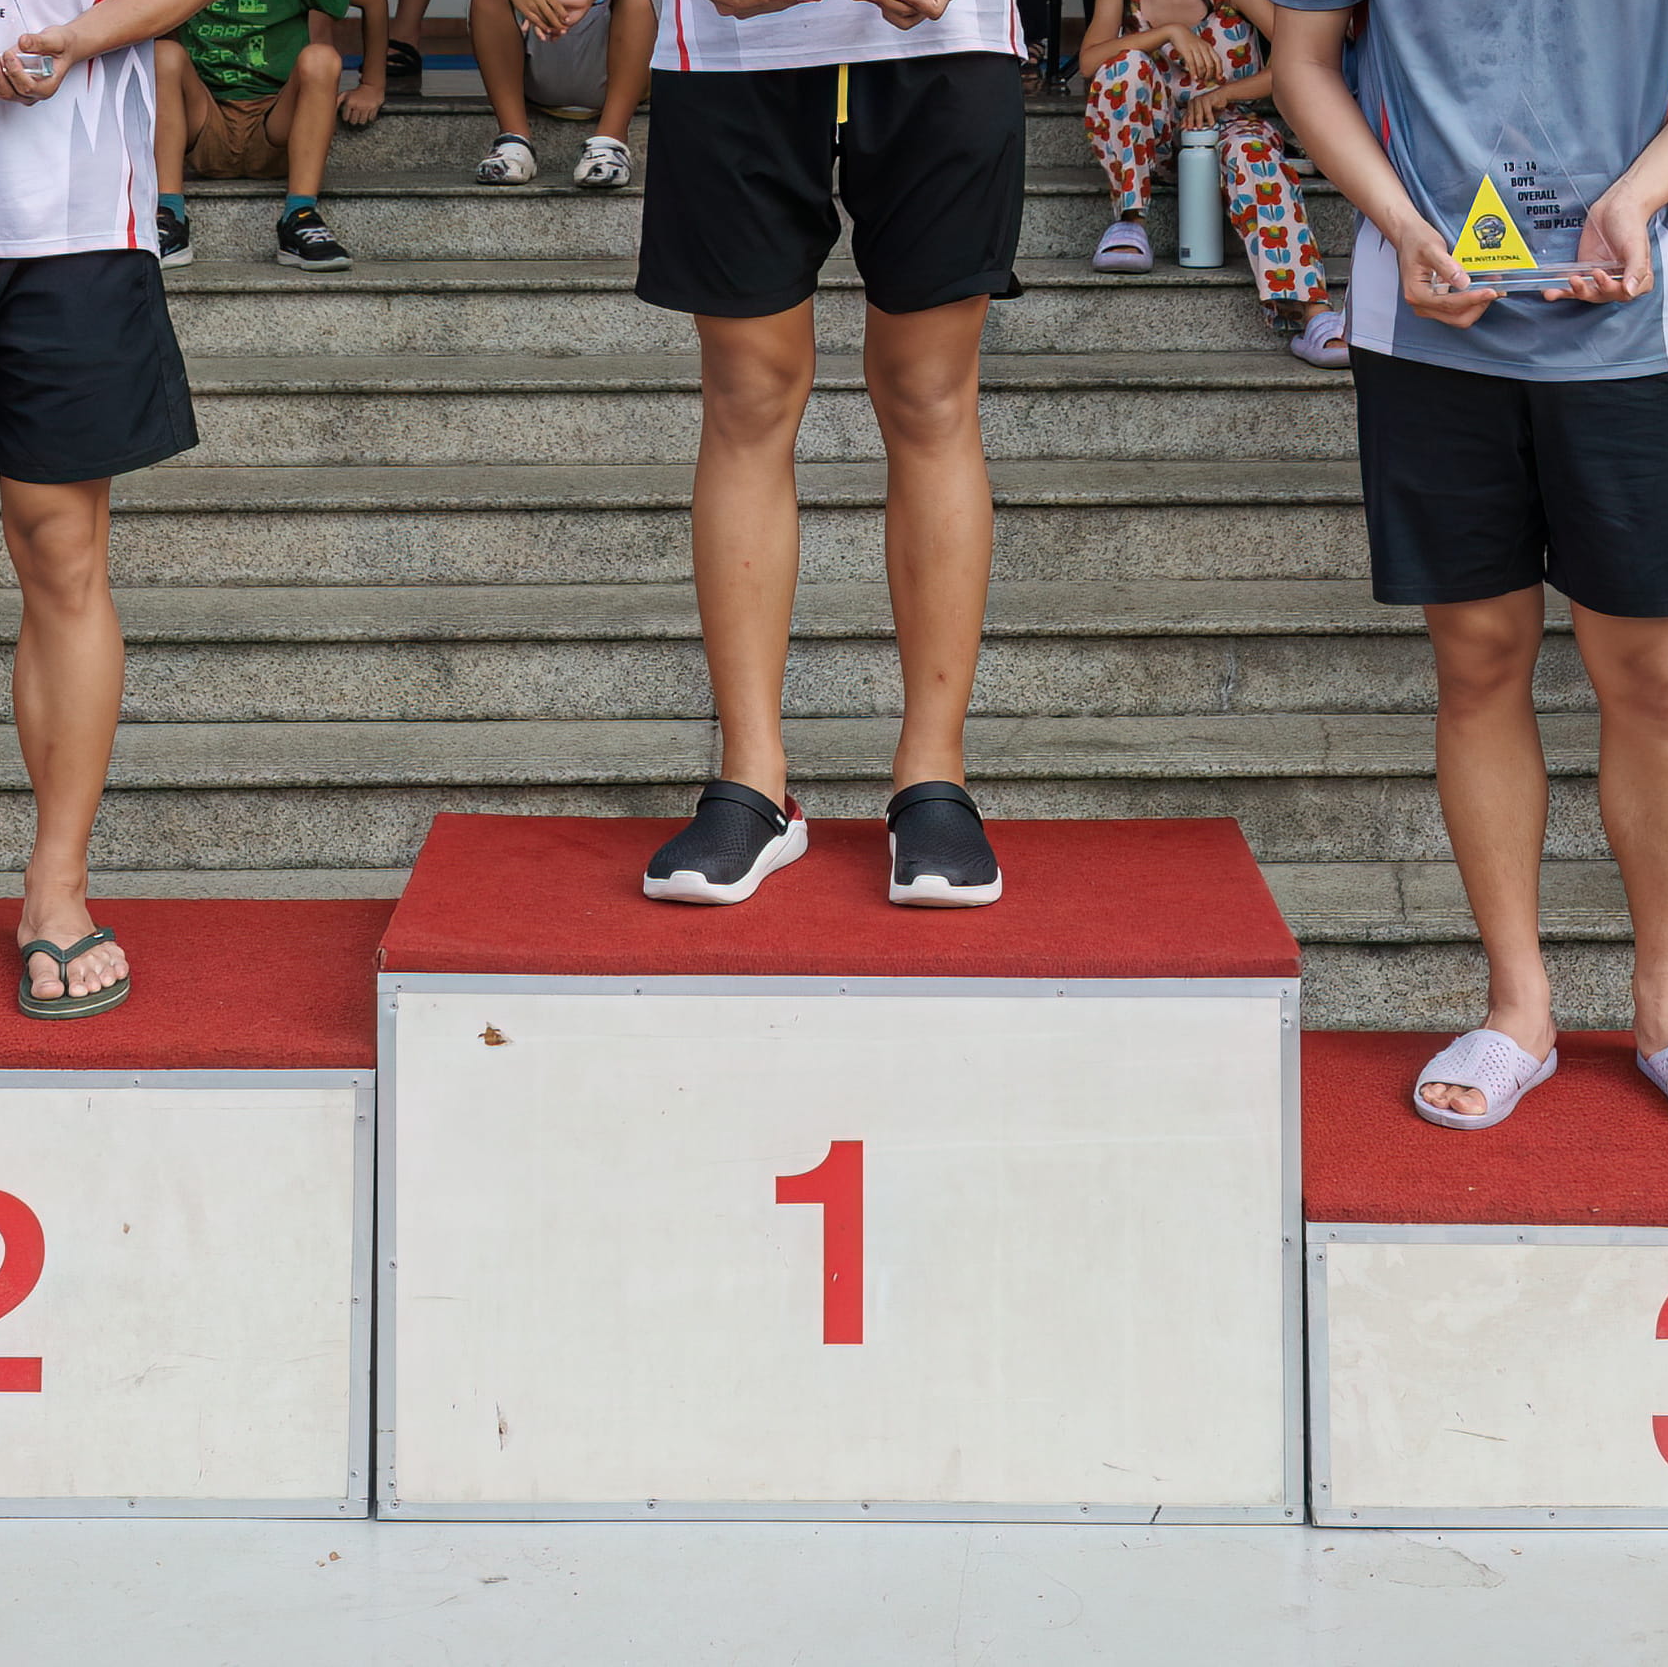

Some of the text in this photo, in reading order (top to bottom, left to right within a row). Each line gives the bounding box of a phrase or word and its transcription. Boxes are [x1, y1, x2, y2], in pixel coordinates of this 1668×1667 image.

[1502, 162, 1515, 172] 13
[1525, 161, 1537, 172] 14
[1510, 177, 1535, 187] BOYS
[1517, 190, 1558, 201] OVERALL
[1526, 204, 1561, 216] POINTS
[1533, 218, 1584, 230] 3RD PLACE
[1474, 254, 1522, 263] INVITATIONAL
[776, 1141, 865, 1345] 1
